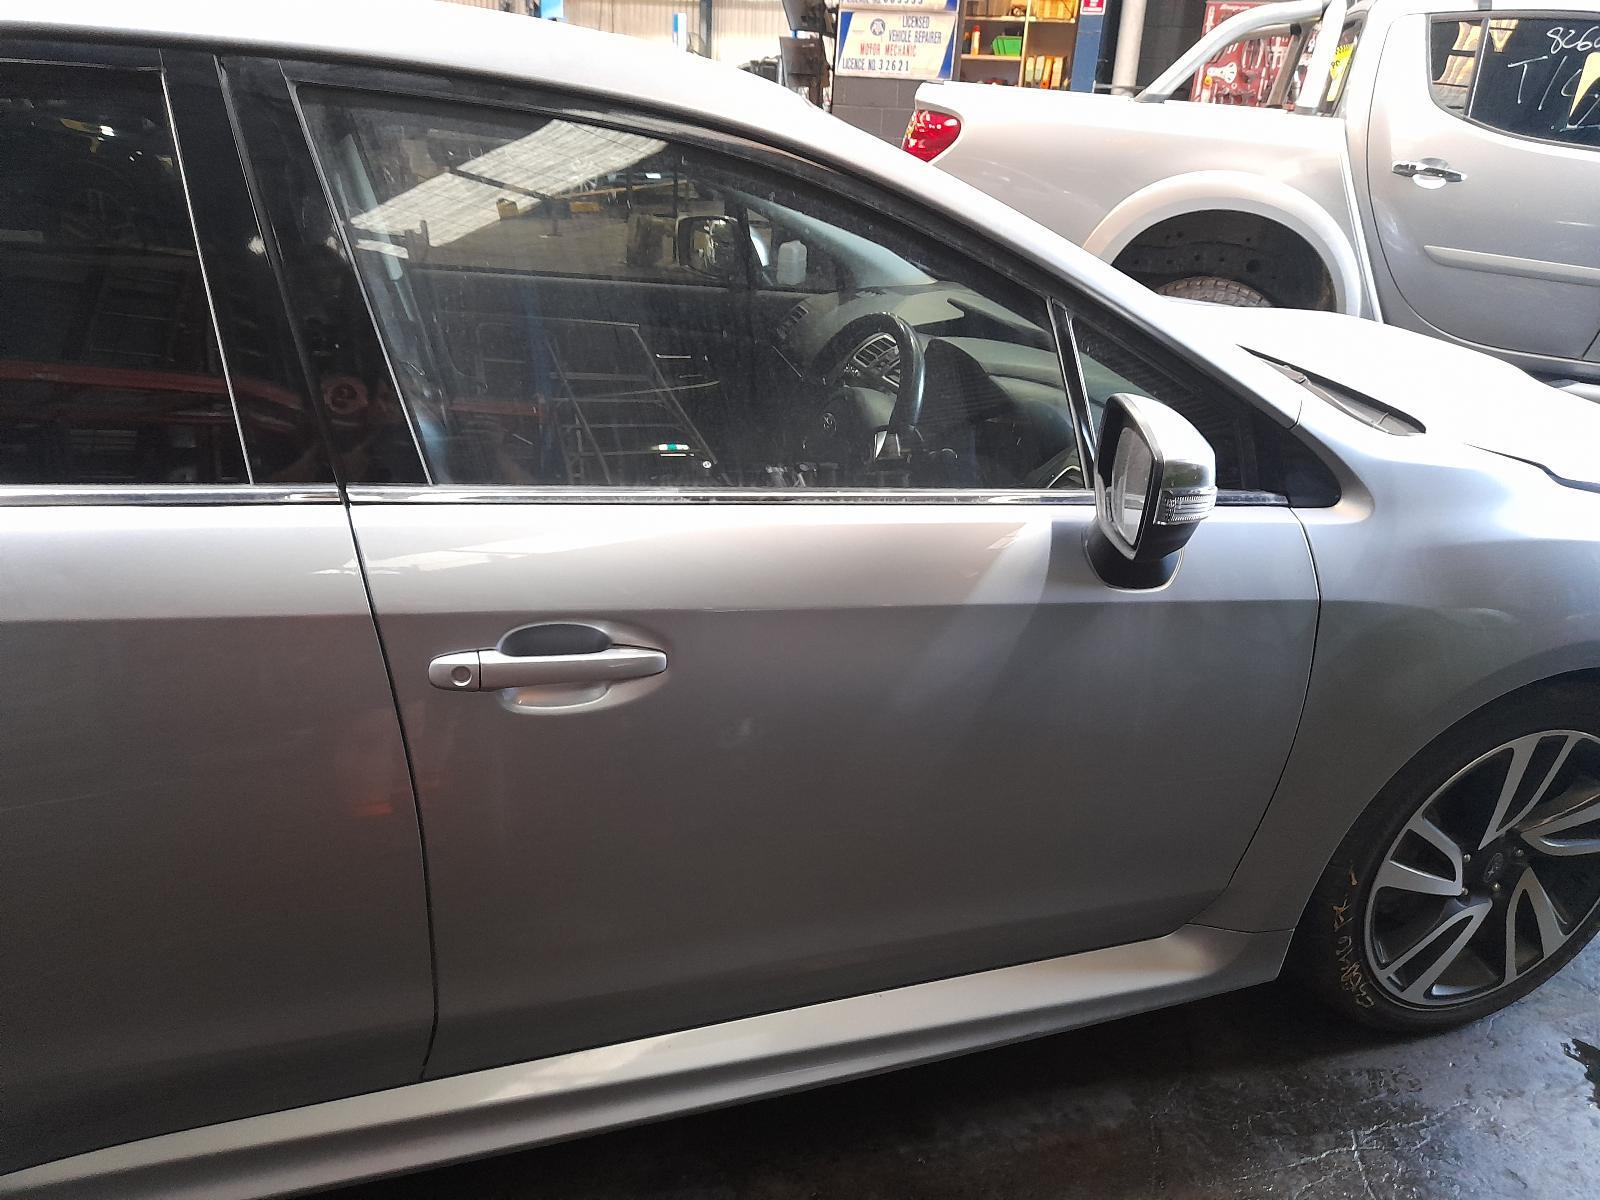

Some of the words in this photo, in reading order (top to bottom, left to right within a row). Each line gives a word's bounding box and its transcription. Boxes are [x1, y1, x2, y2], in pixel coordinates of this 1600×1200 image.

[902, 16, 929, 28] LICENSED
[889, 30, 911, 43] VEHICLE
[914, 31, 942, 44] REPAIRER
[860, 43, 880, 56] MOTOR
[884, 43, 917, 57] MECHANIC
[842, 57, 864, 70] LICENCE
[878, 59, 909, 71] 32621
